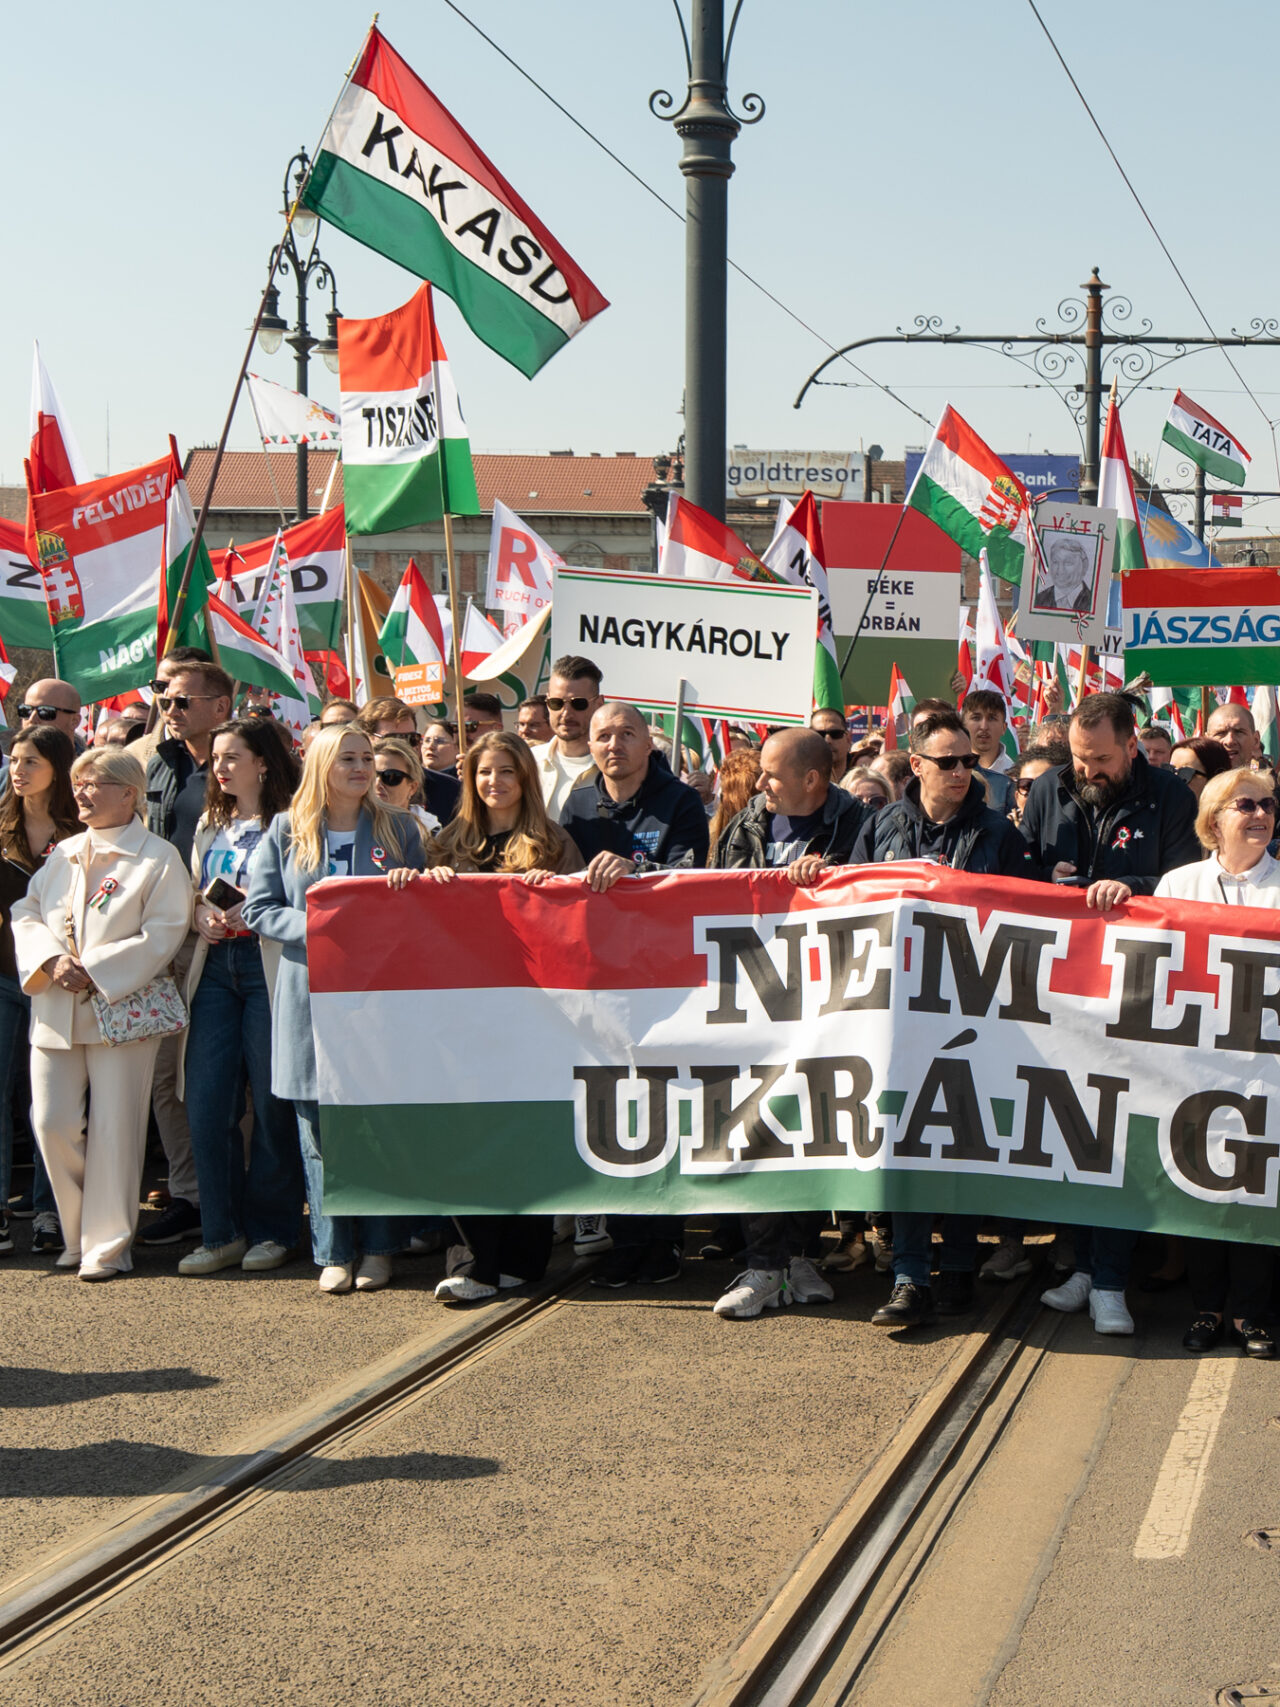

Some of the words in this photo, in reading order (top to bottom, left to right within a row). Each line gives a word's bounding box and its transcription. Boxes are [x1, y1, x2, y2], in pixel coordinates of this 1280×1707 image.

[361, 111, 573, 304] KAKASD
[1192, 420, 1231, 456] TATA
[728, 462, 861, 486] goldtresor
[1014, 471, 1057, 486] Bank
[495, 588, 531, 604] RUCH
[867, 575, 914, 596] BÉKE
[579, 613, 790, 661] NAGYKÁROLY
[860, 612, 920, 632] ORBÁN
[705, 911, 1058, 1025] NEM
[573, 1028, 1130, 1174] UKRÁN
